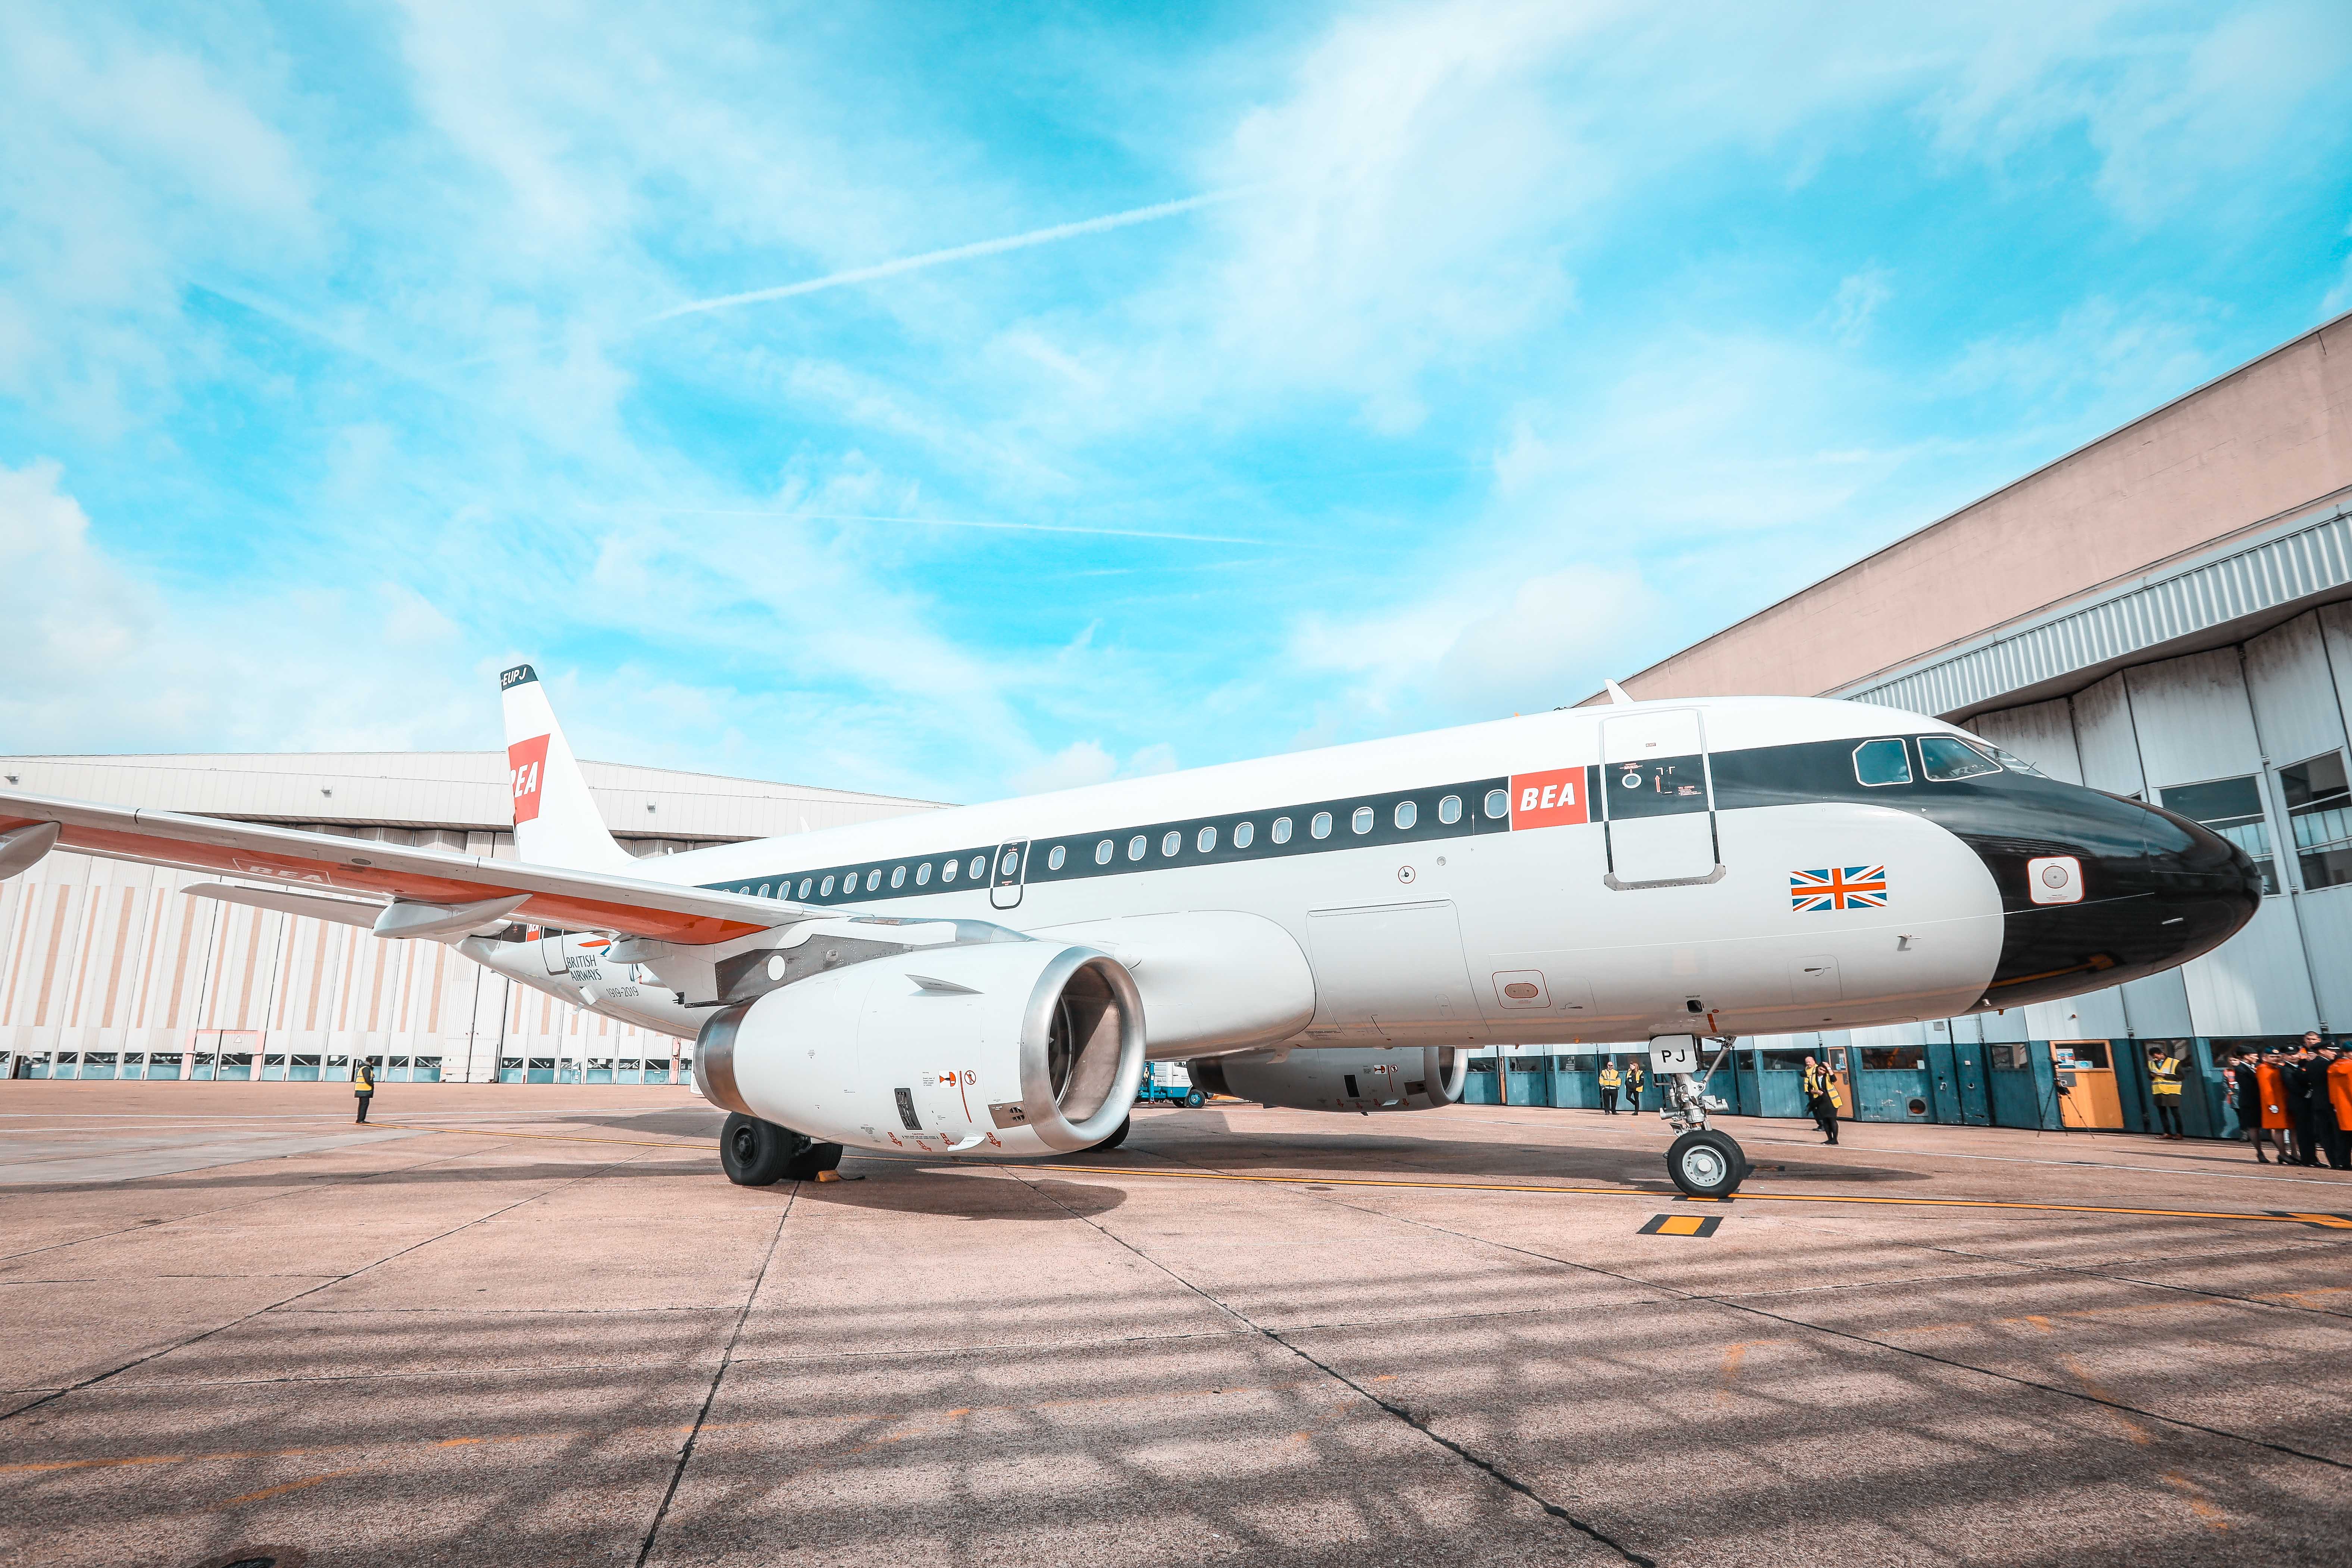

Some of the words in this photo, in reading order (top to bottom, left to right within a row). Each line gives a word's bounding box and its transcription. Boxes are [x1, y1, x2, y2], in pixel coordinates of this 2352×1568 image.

[1520, 782, 1576, 812] BEA
[249, 866, 323, 882] BEA
[566, 955, 597, 968] BRITISH
[570, 969, 602, 981] AIRWAYS
[606, 986, 639, 998] 1919-2019
